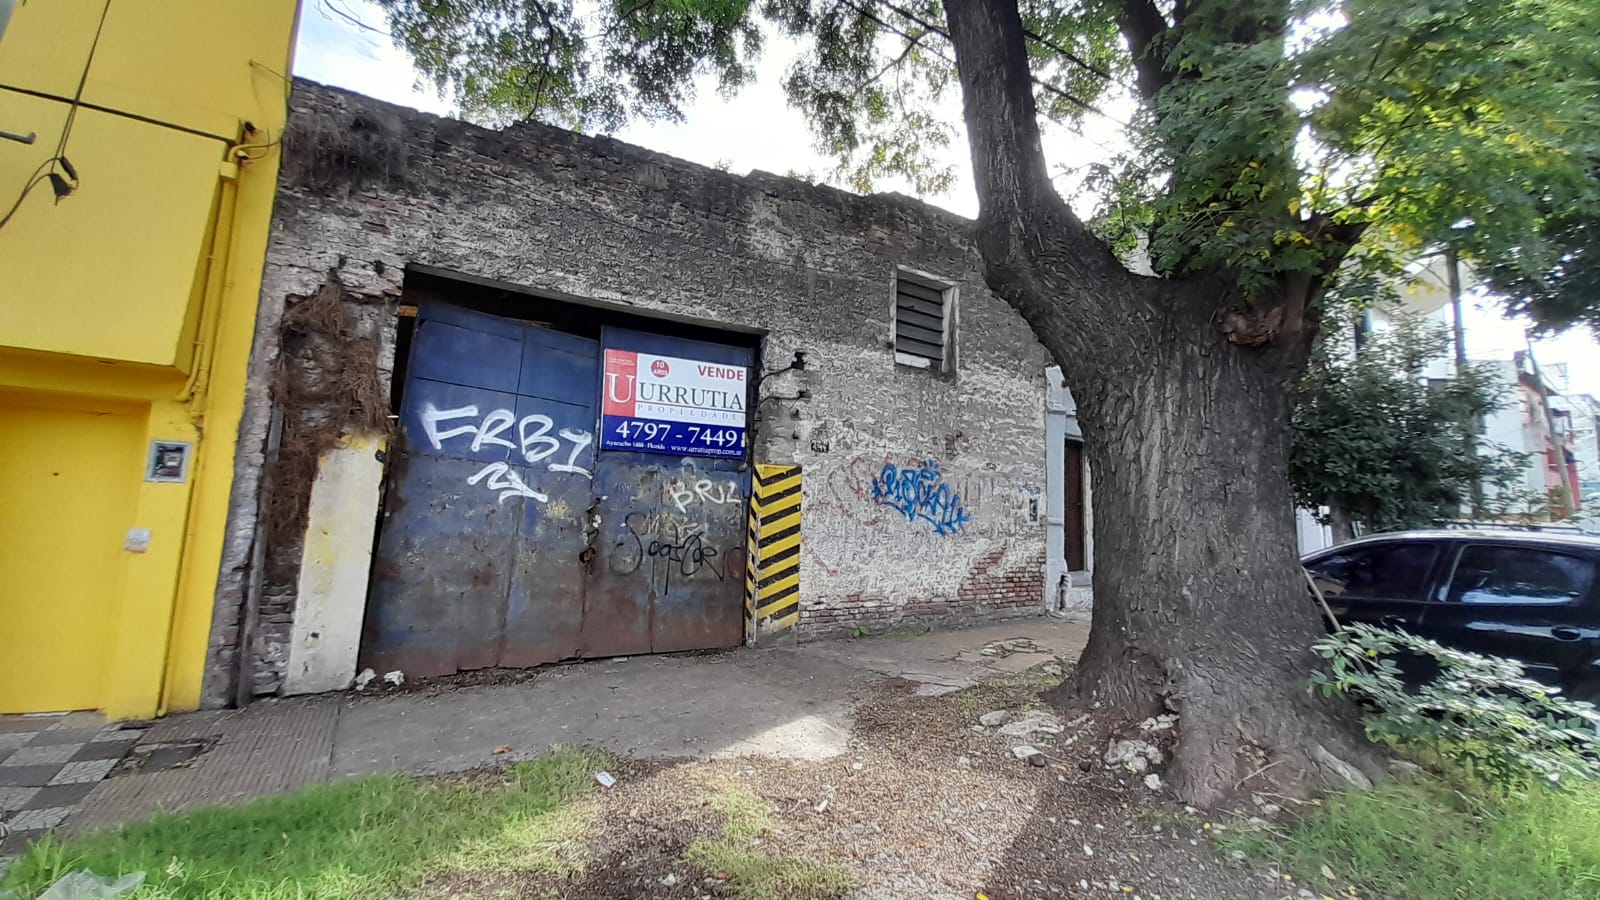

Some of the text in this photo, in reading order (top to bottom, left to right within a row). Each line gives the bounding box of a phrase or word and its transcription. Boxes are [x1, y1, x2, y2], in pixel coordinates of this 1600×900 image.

[655, 361, 665, 369] 10
[698, 365, 744, 381] VENDE
[605, 372, 636, 403] U
[639, 382, 743, 410] URRUTIA
[638, 403, 745, 421] PROPIEDADES
[615, 420, 671, 442] 4797
[687, 427, 738, 448] 7449
